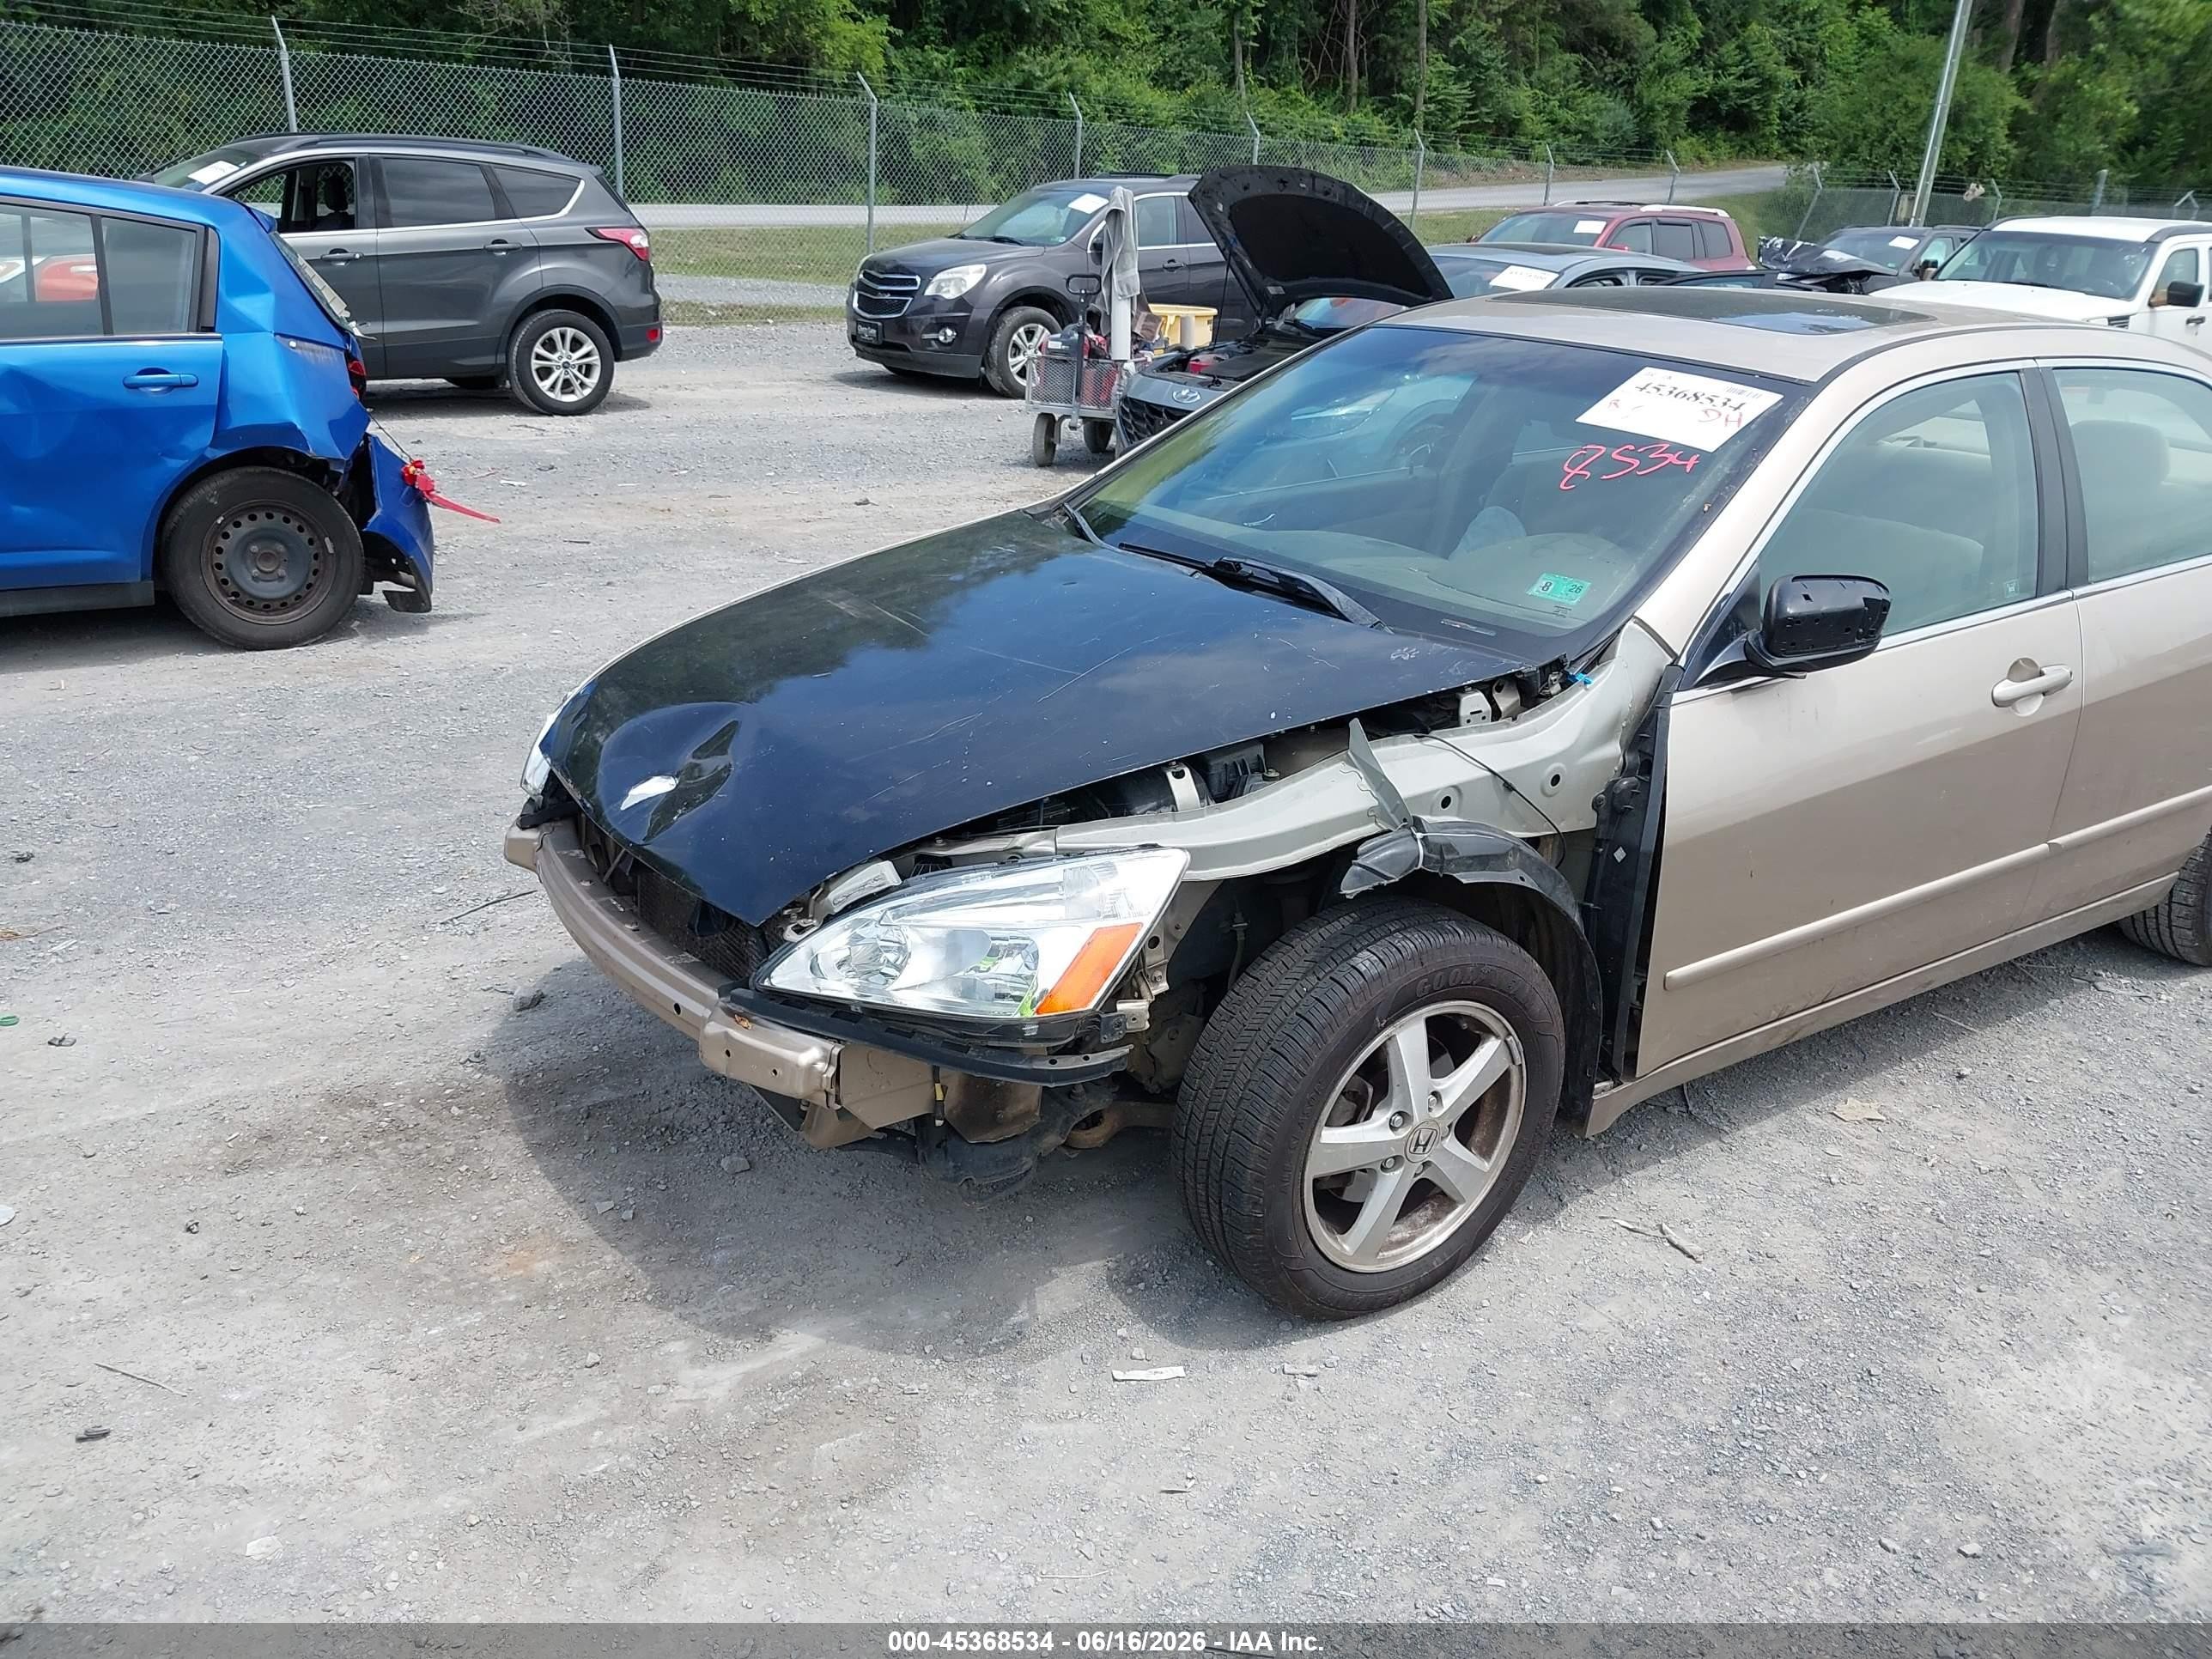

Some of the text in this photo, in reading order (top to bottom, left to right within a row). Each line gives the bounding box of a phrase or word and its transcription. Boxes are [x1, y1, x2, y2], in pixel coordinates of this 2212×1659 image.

[1635, 382, 1747, 412] 45368534
[1559, 443, 1700, 490] 8534
[1541, 581, 1583, 594] 8 26
